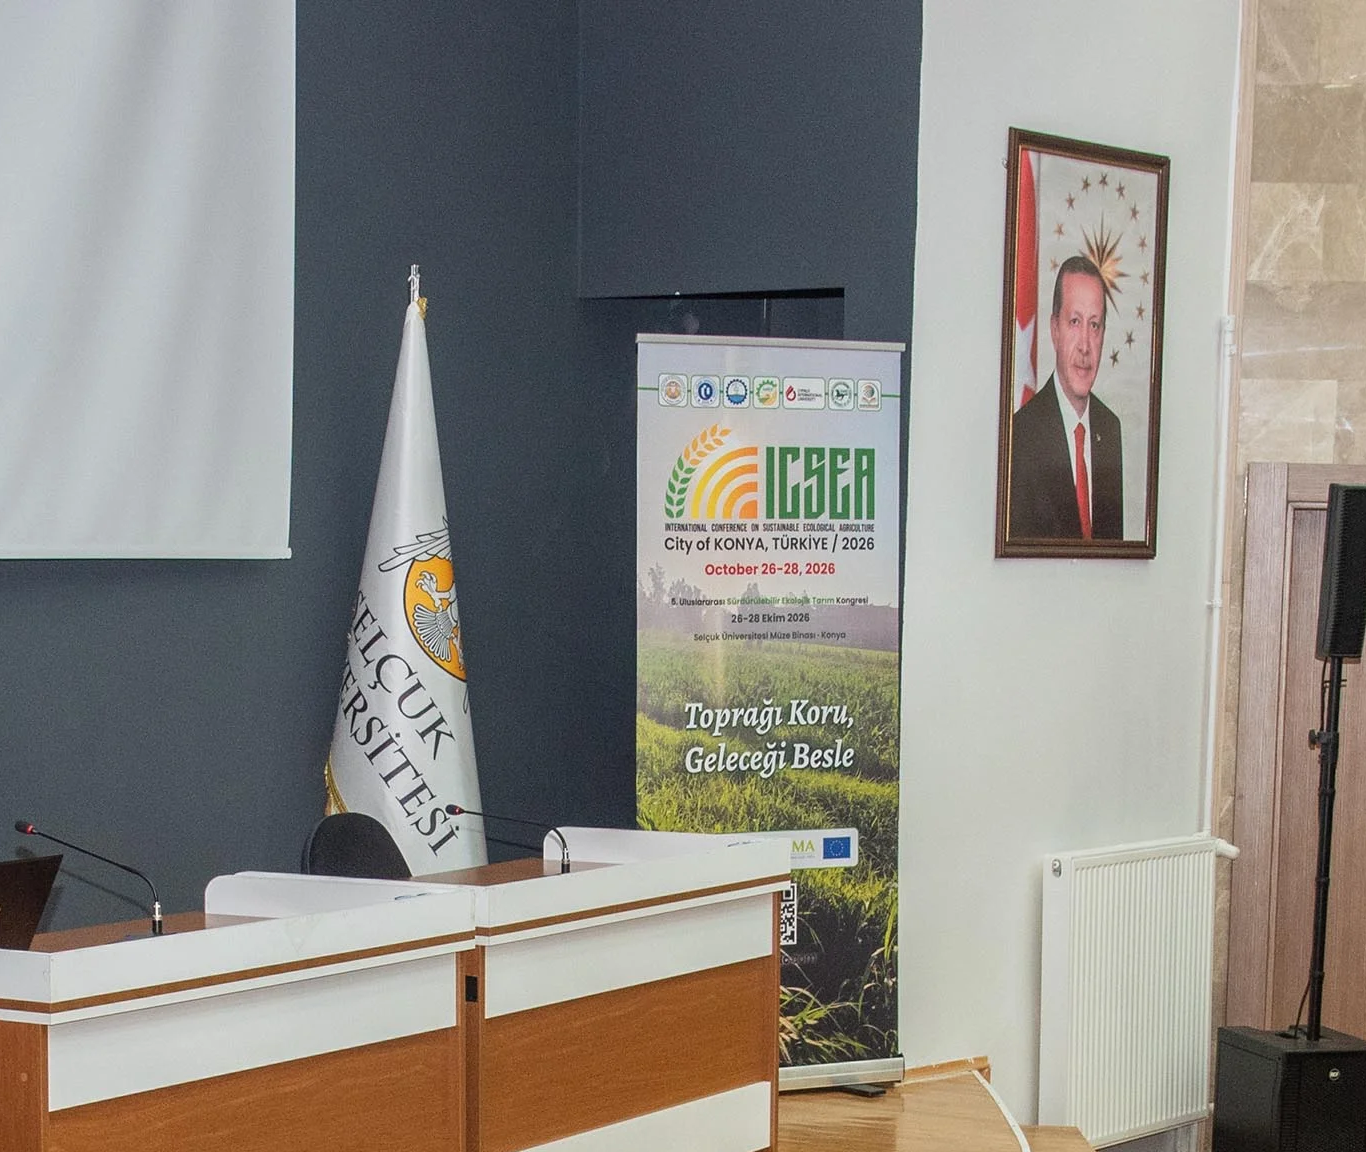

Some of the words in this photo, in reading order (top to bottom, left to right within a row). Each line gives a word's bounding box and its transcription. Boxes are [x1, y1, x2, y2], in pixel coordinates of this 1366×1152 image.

[765, 446, 875, 520] ICSEA
[665, 524, 707, 532] INTERNATIONAL
[711, 524, 747, 532] CONFERENCE
[751, 524, 759, 532] ON
[763, 524, 799, 532] SUSTAINABLE
[803, 524, 835, 532] ECOLOGICAL
[839, 524, 875, 533] AGRICULTURE
[664, 536, 693, 555] City
[697, 536, 711, 551] of
[715, 538, 769, 552] KONYA,
[772, 534, 828, 551] TÜRKİYE
[831, 534, 839, 553] /
[841, 537, 875, 551] 2026
[705, 563, 759, 576] October
[761, 563, 803, 577] 26-28,
[805, 563, 835, 575] 2026
[679, 597, 725, 606] Uluslararası
[727, 596, 780, 606] Sürdürülebilir
[811, 597, 835, 605] Tarım
[836, 596, 869, 606] Kongresi
[731, 614, 760, 624] 26-28
[762, 613, 785, 623] Ekim
[787, 612, 810, 622] 2026
[693, 632, 720, 643] Selçuk
[721, 630, 769, 642] Üniversitesi
[770, 630, 791, 640] Müze
[792, 630, 815, 640] Binası
[821, 630, 846, 642] Konya
[685, 700, 783, 736] Toprağı
[787, 700, 854, 728] Koru,
[685, 741, 787, 779] Geleceği
[791, 740, 855, 770] Besle
